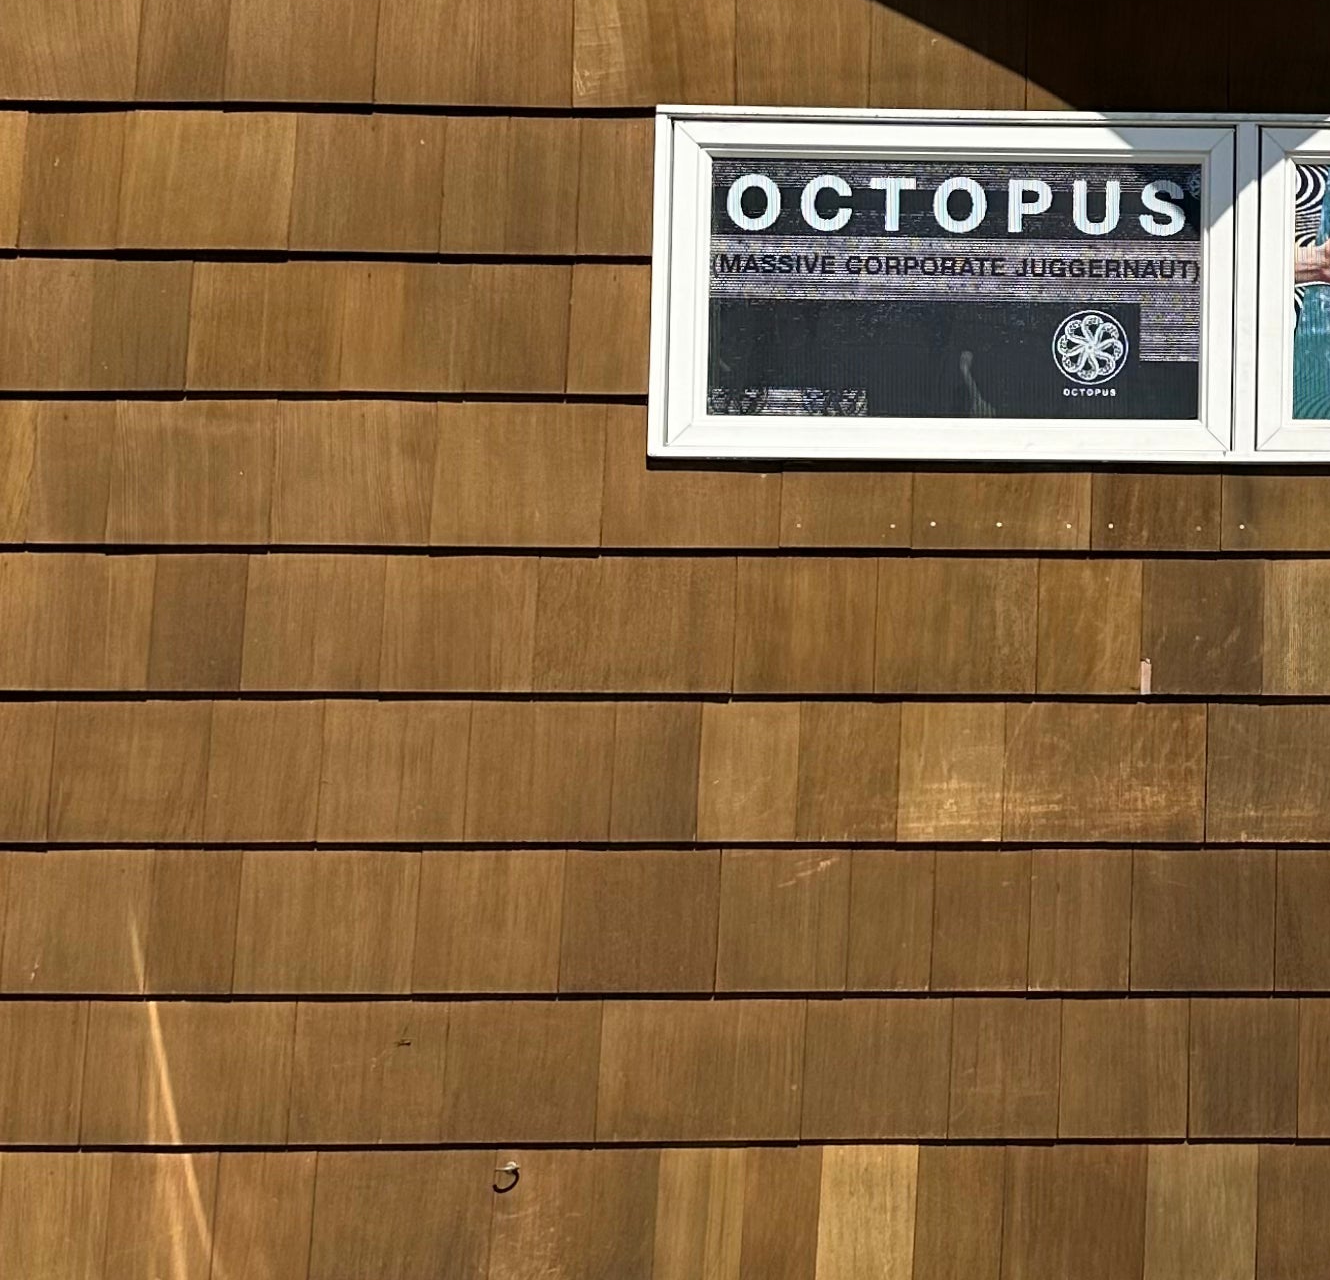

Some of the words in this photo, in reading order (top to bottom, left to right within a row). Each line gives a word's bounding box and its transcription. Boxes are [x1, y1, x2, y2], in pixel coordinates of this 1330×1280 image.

[726, 173, 1186, 237] OCTOPUS
[713, 254, 836, 278] (MASSIVE
[846, 256, 1005, 277] CORPORATE
[1016, 258, 1200, 283] JUGGERNAUT)
[1063, 388, 1117, 397] OCTOPUS
